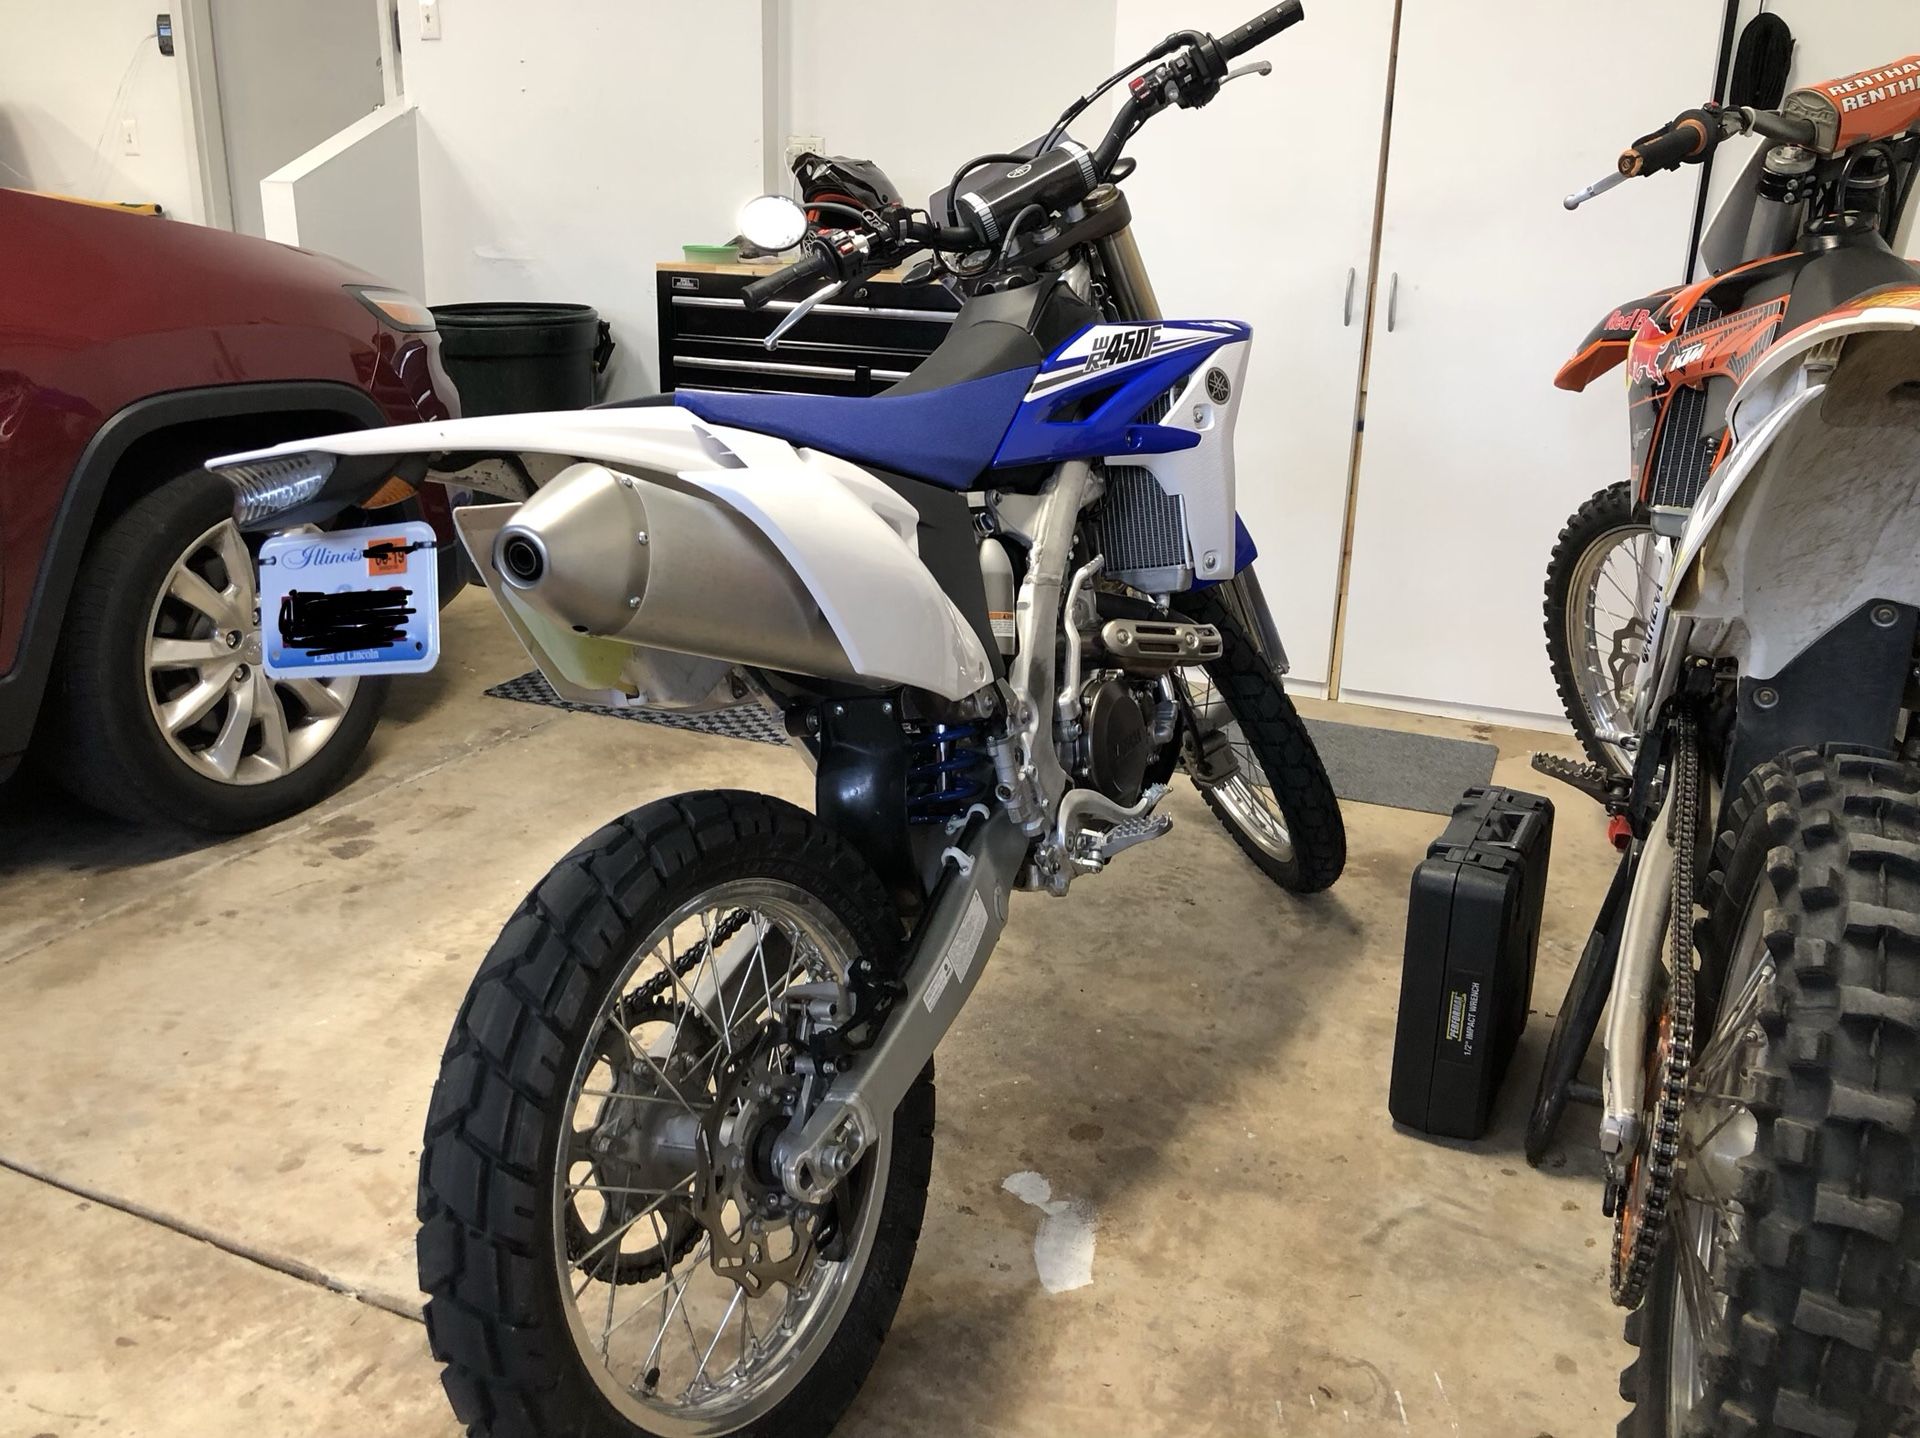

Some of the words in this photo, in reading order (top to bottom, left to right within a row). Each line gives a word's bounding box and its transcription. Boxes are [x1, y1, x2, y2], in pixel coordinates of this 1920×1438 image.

[1603, 309, 1640, 331] Red
[1669, 343, 1707, 372] KTM
[281, 544, 363, 570] Illinois
[336, 651, 345, 662] of
[347, 648, 379, 661] Lincoln
[1468, 981, 1481, 1012] WRENCH
[1449, 991, 1463, 1040] PERFORMAX
[1465, 1012, 1476, 1040] IMPACT
